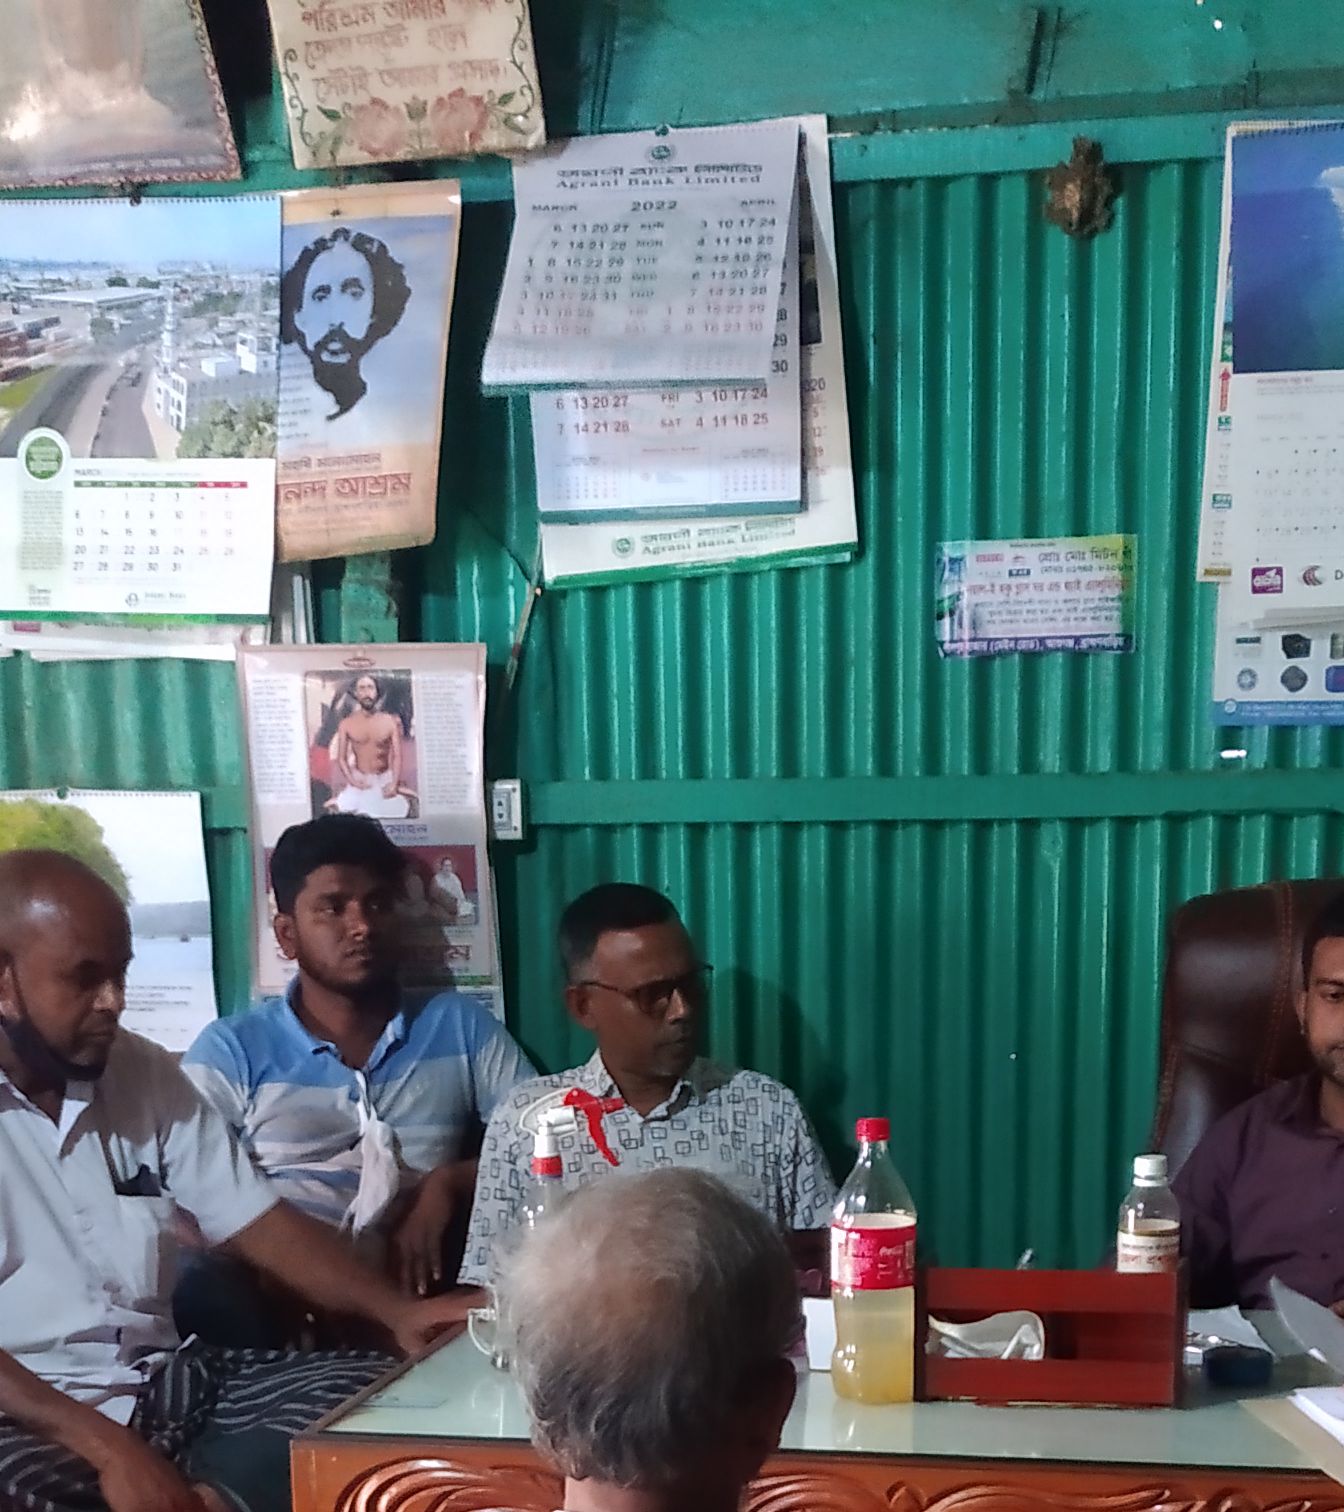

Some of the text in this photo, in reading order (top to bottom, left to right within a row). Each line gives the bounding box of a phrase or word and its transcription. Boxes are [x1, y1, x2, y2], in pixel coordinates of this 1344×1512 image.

[628, 178, 675, 187] Bank
[685, 175, 761, 185] Limited
[631, 201, 677, 211] 2022
[771, 360, 788, 373] 30
[574, 397, 589, 409] 13
[593, 396, 609, 408] 20
[612, 395, 628, 408] 27
[661, 391, 680, 403] FRI
[712, 390, 727, 402] 10
[734, 389, 747, 400] 17
[752, 387, 767, 399] 24
[574, 423, 589, 434] 14
[593, 422, 608, 433] 21
[614, 421, 629, 433] 28
[661, 418, 681, 428] SAT
[713, 415, 726, 427] 11
[735, 414, 748, 426] 18
[753, 413, 769, 425] 25
[277, 472, 412, 500] নন্দ আশ্রম
